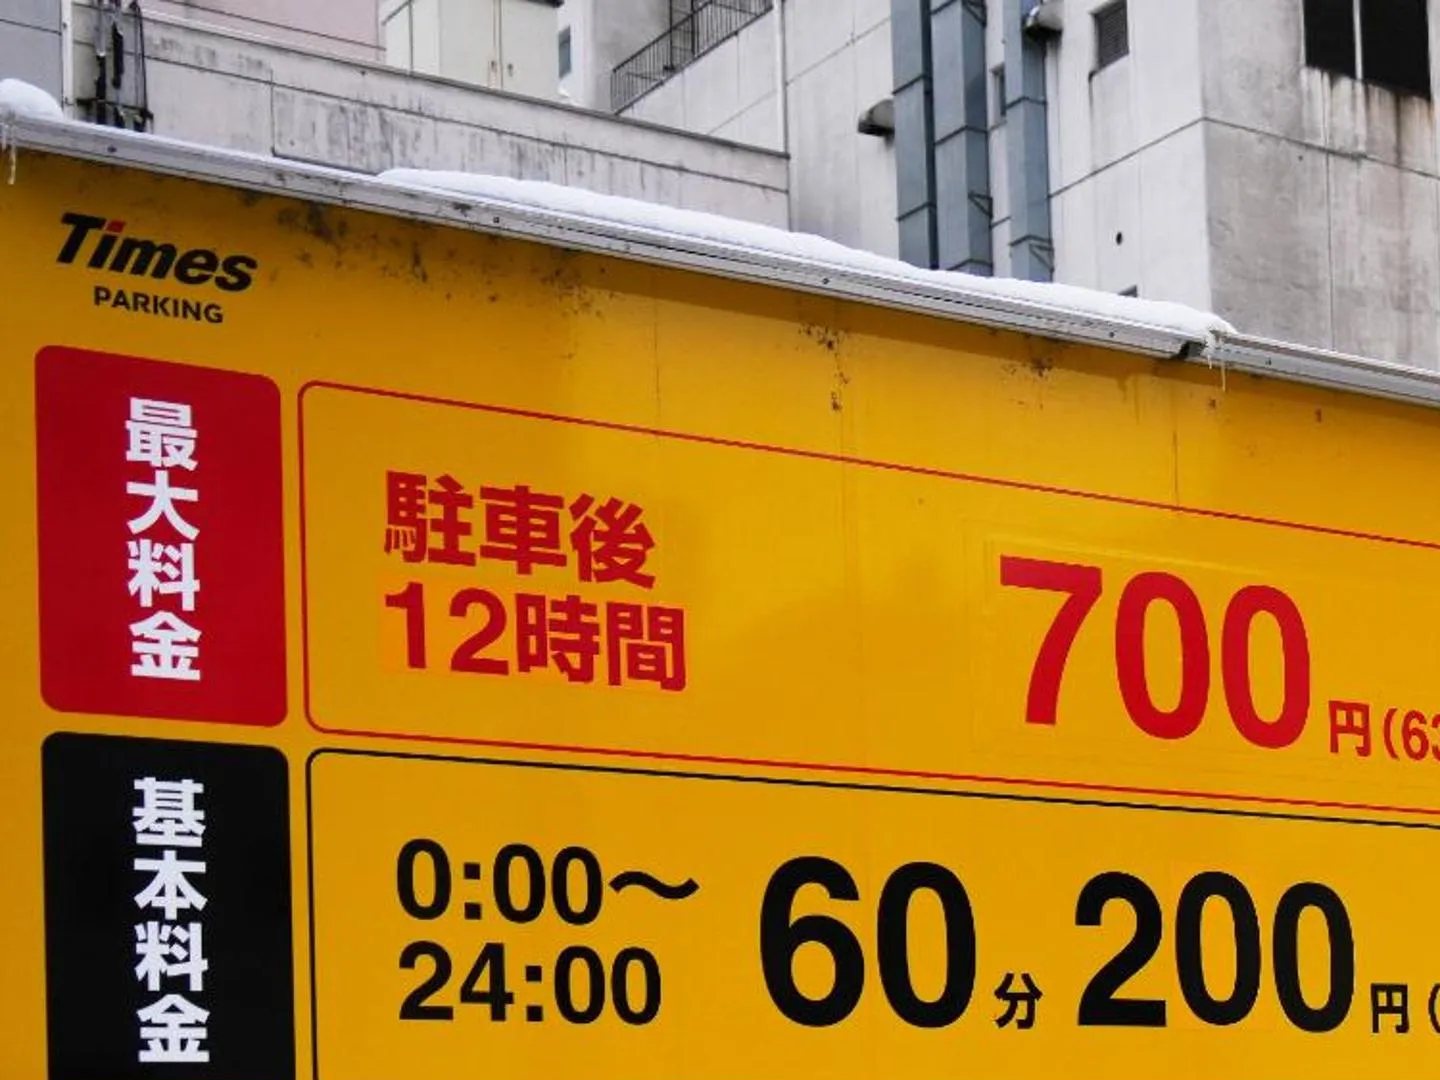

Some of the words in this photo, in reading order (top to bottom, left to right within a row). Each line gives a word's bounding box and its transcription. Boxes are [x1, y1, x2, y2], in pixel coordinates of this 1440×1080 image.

[56, 212, 259, 293] Times
[92, 285, 224, 325] PARKING
[125, 396, 202, 682] 最大料金
[384, 470, 657, 590] 駐車後
[384, 582, 687, 692] 12時間
[132, 776, 211, 1064] 基本料金
[398, 941, 663, 1026] 24:00
